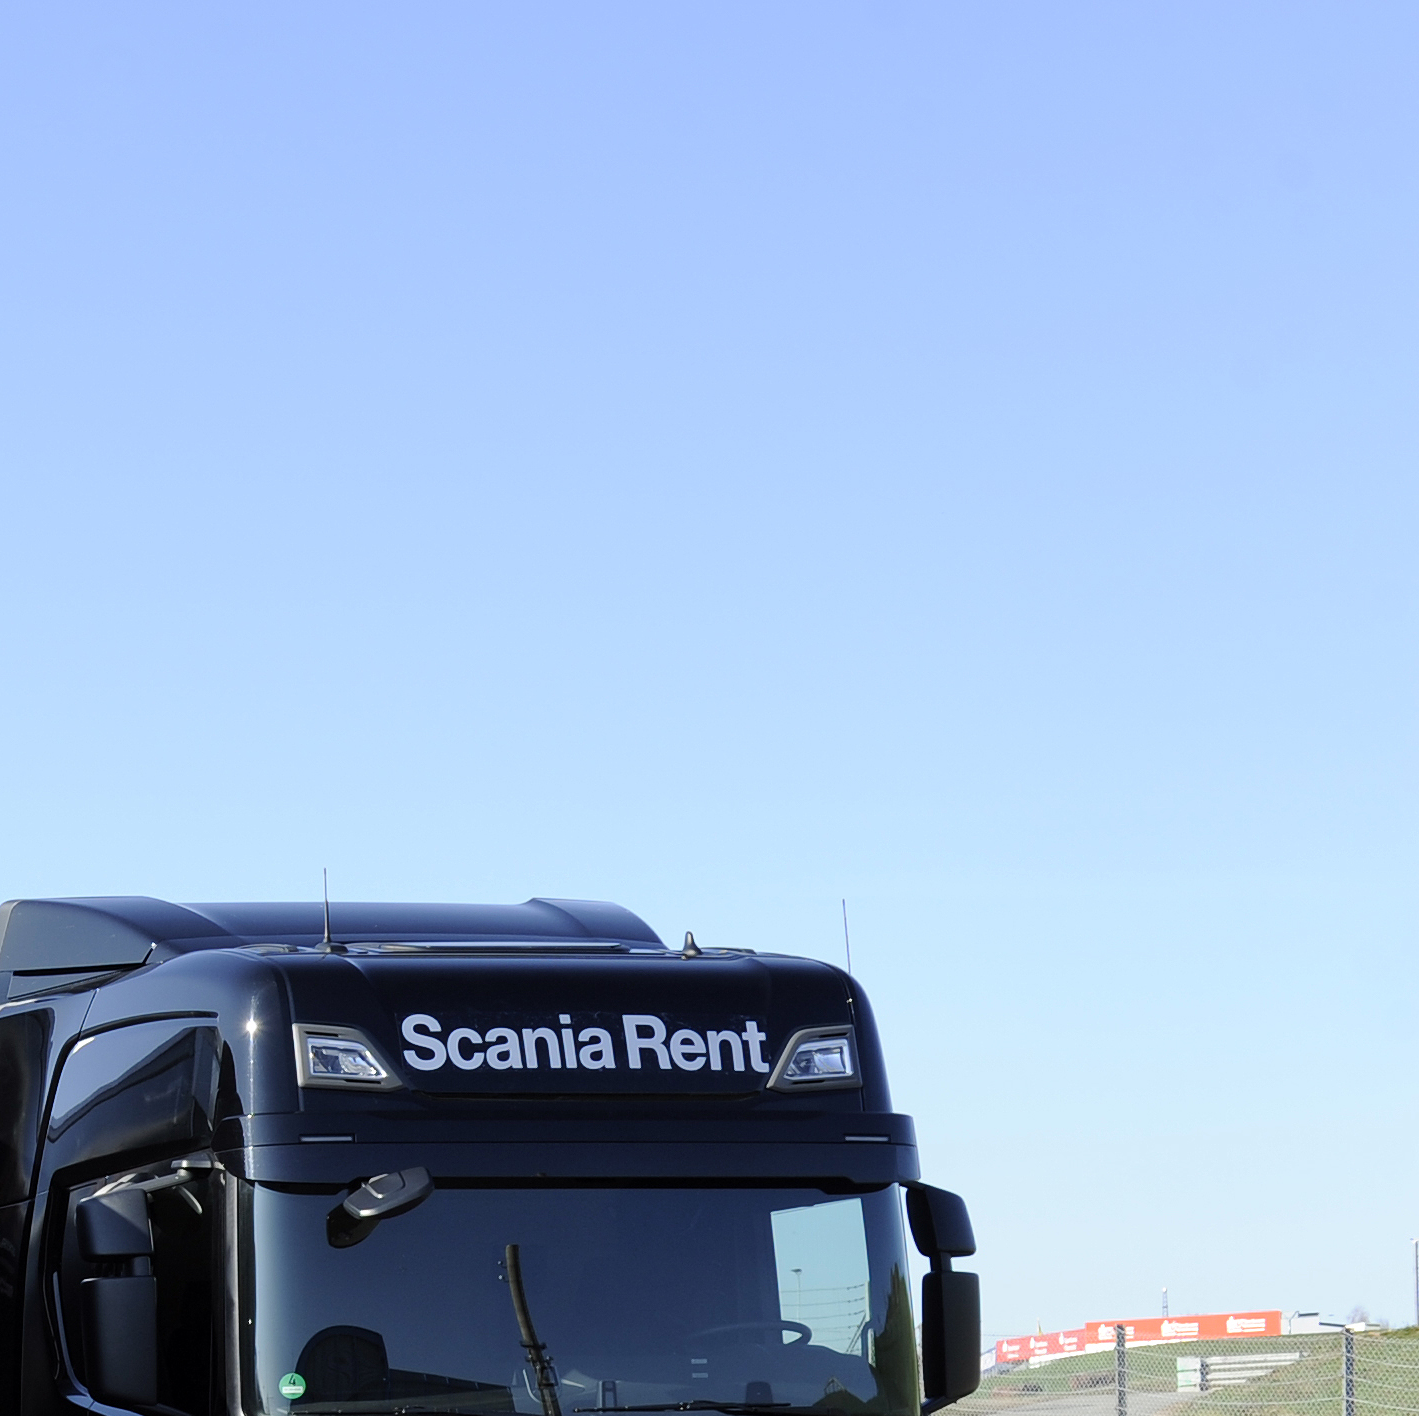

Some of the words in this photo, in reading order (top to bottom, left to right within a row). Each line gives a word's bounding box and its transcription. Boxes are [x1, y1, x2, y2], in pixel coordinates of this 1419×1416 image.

[401, 1013, 616, 1071] Scania
[622, 1014, 770, 1073] Rent
[288, 1373, 296, 1386] 4
